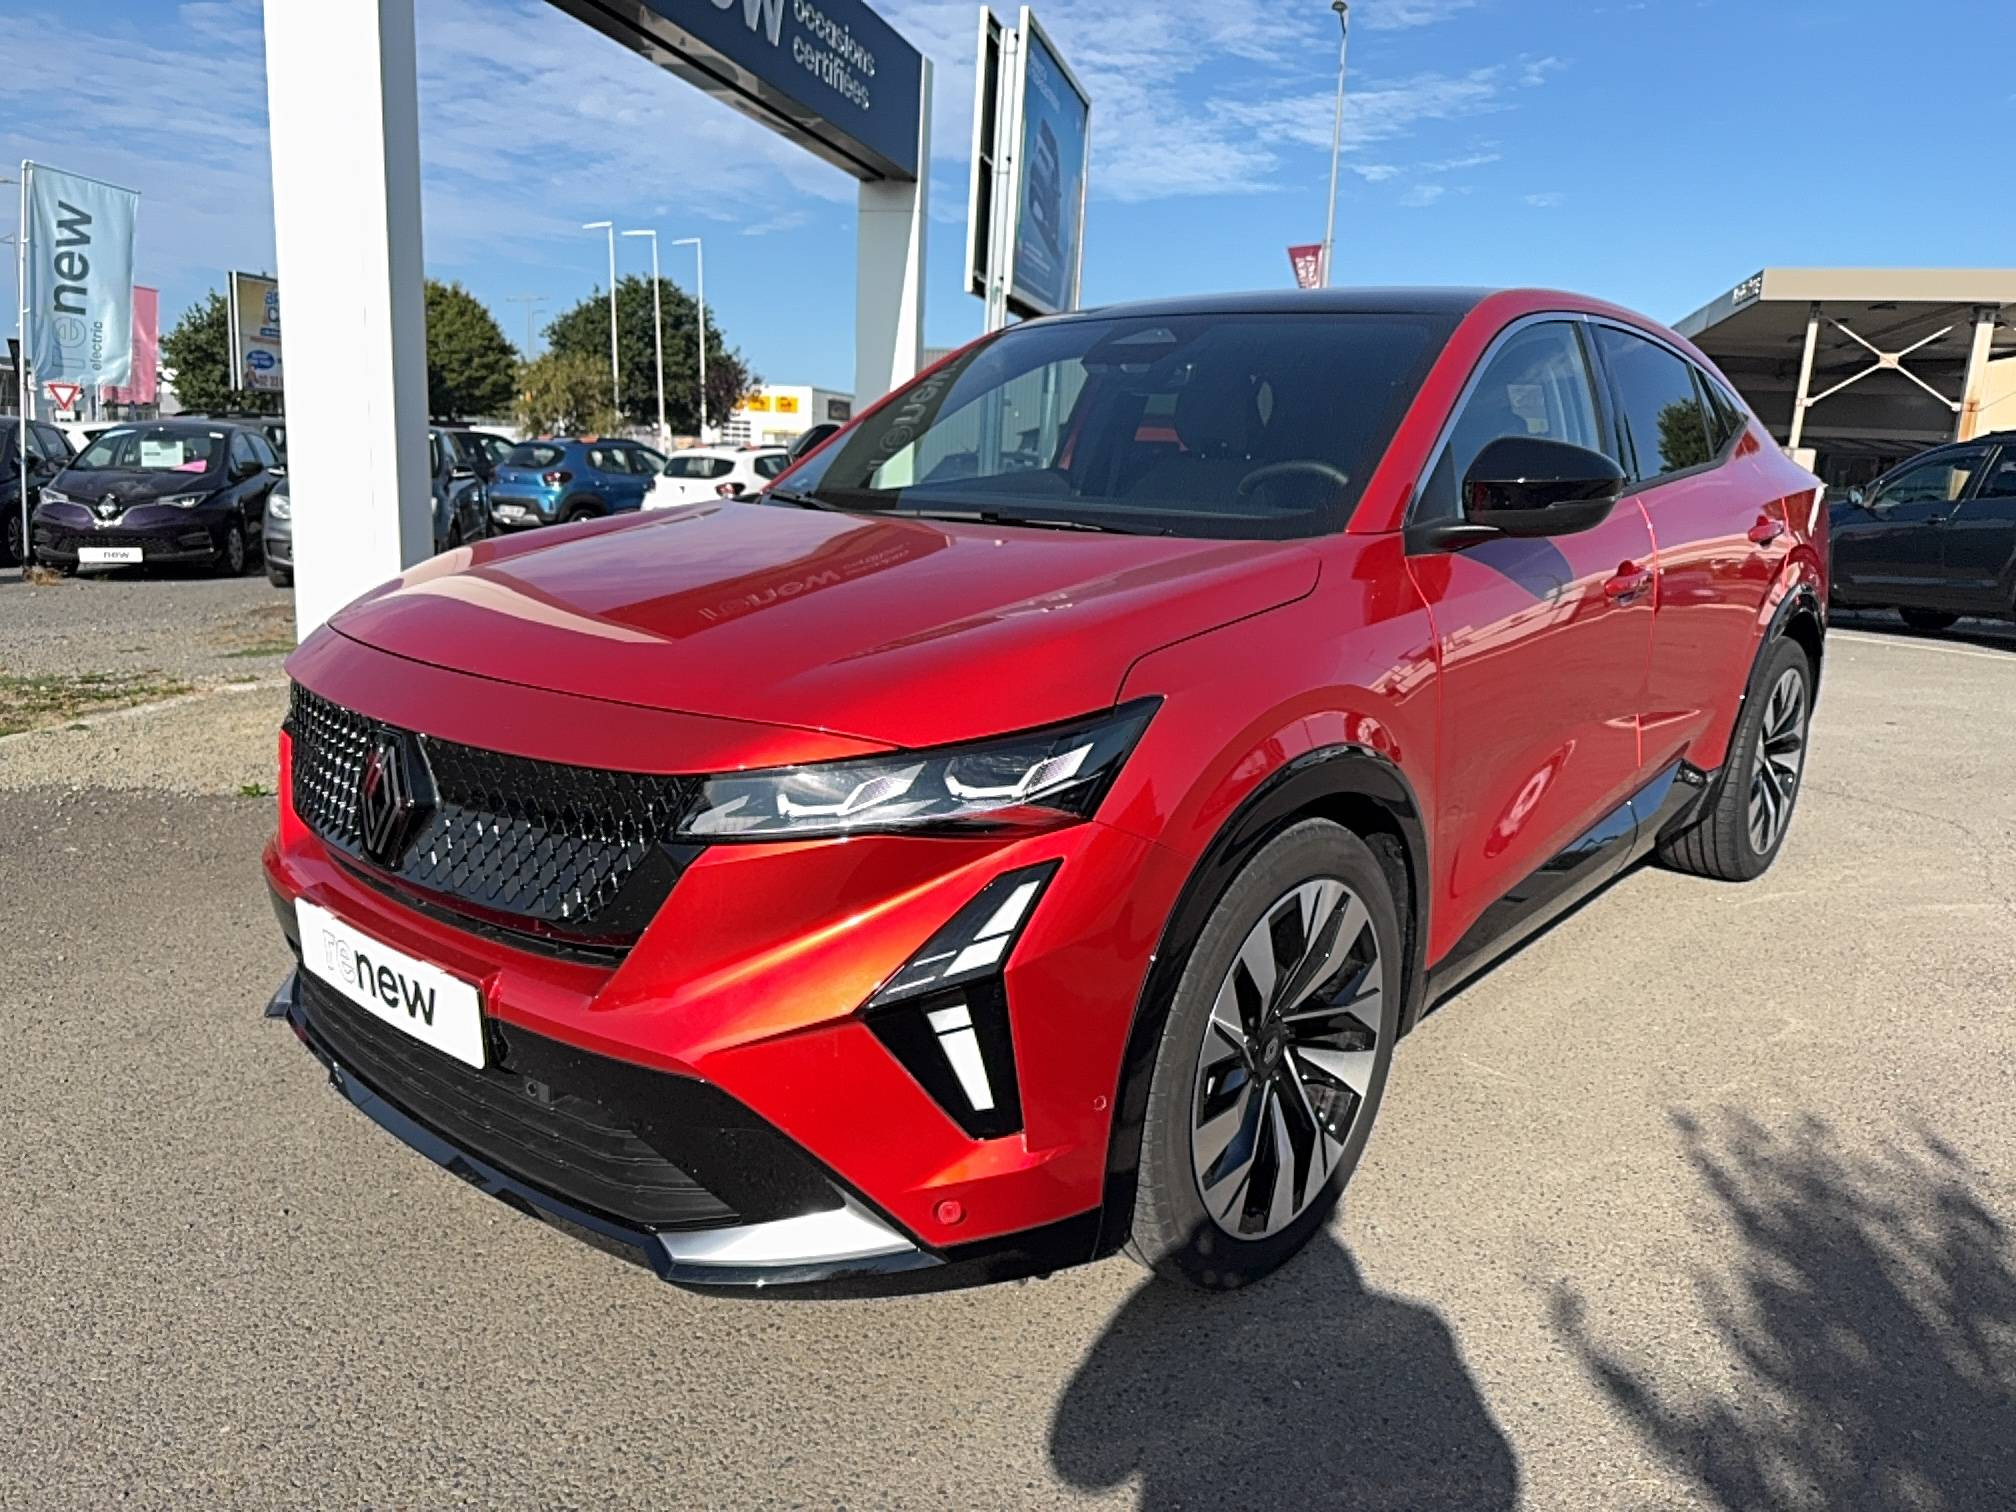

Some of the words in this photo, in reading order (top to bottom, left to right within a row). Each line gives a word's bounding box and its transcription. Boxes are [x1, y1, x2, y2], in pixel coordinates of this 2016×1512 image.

[793, 35, 870, 110] certifiées
[794, 0, 875, 77] occasions
[51, 200, 93, 370] renew
[90, 321, 103, 371] electric
[322, 929, 436, 1027] renew
